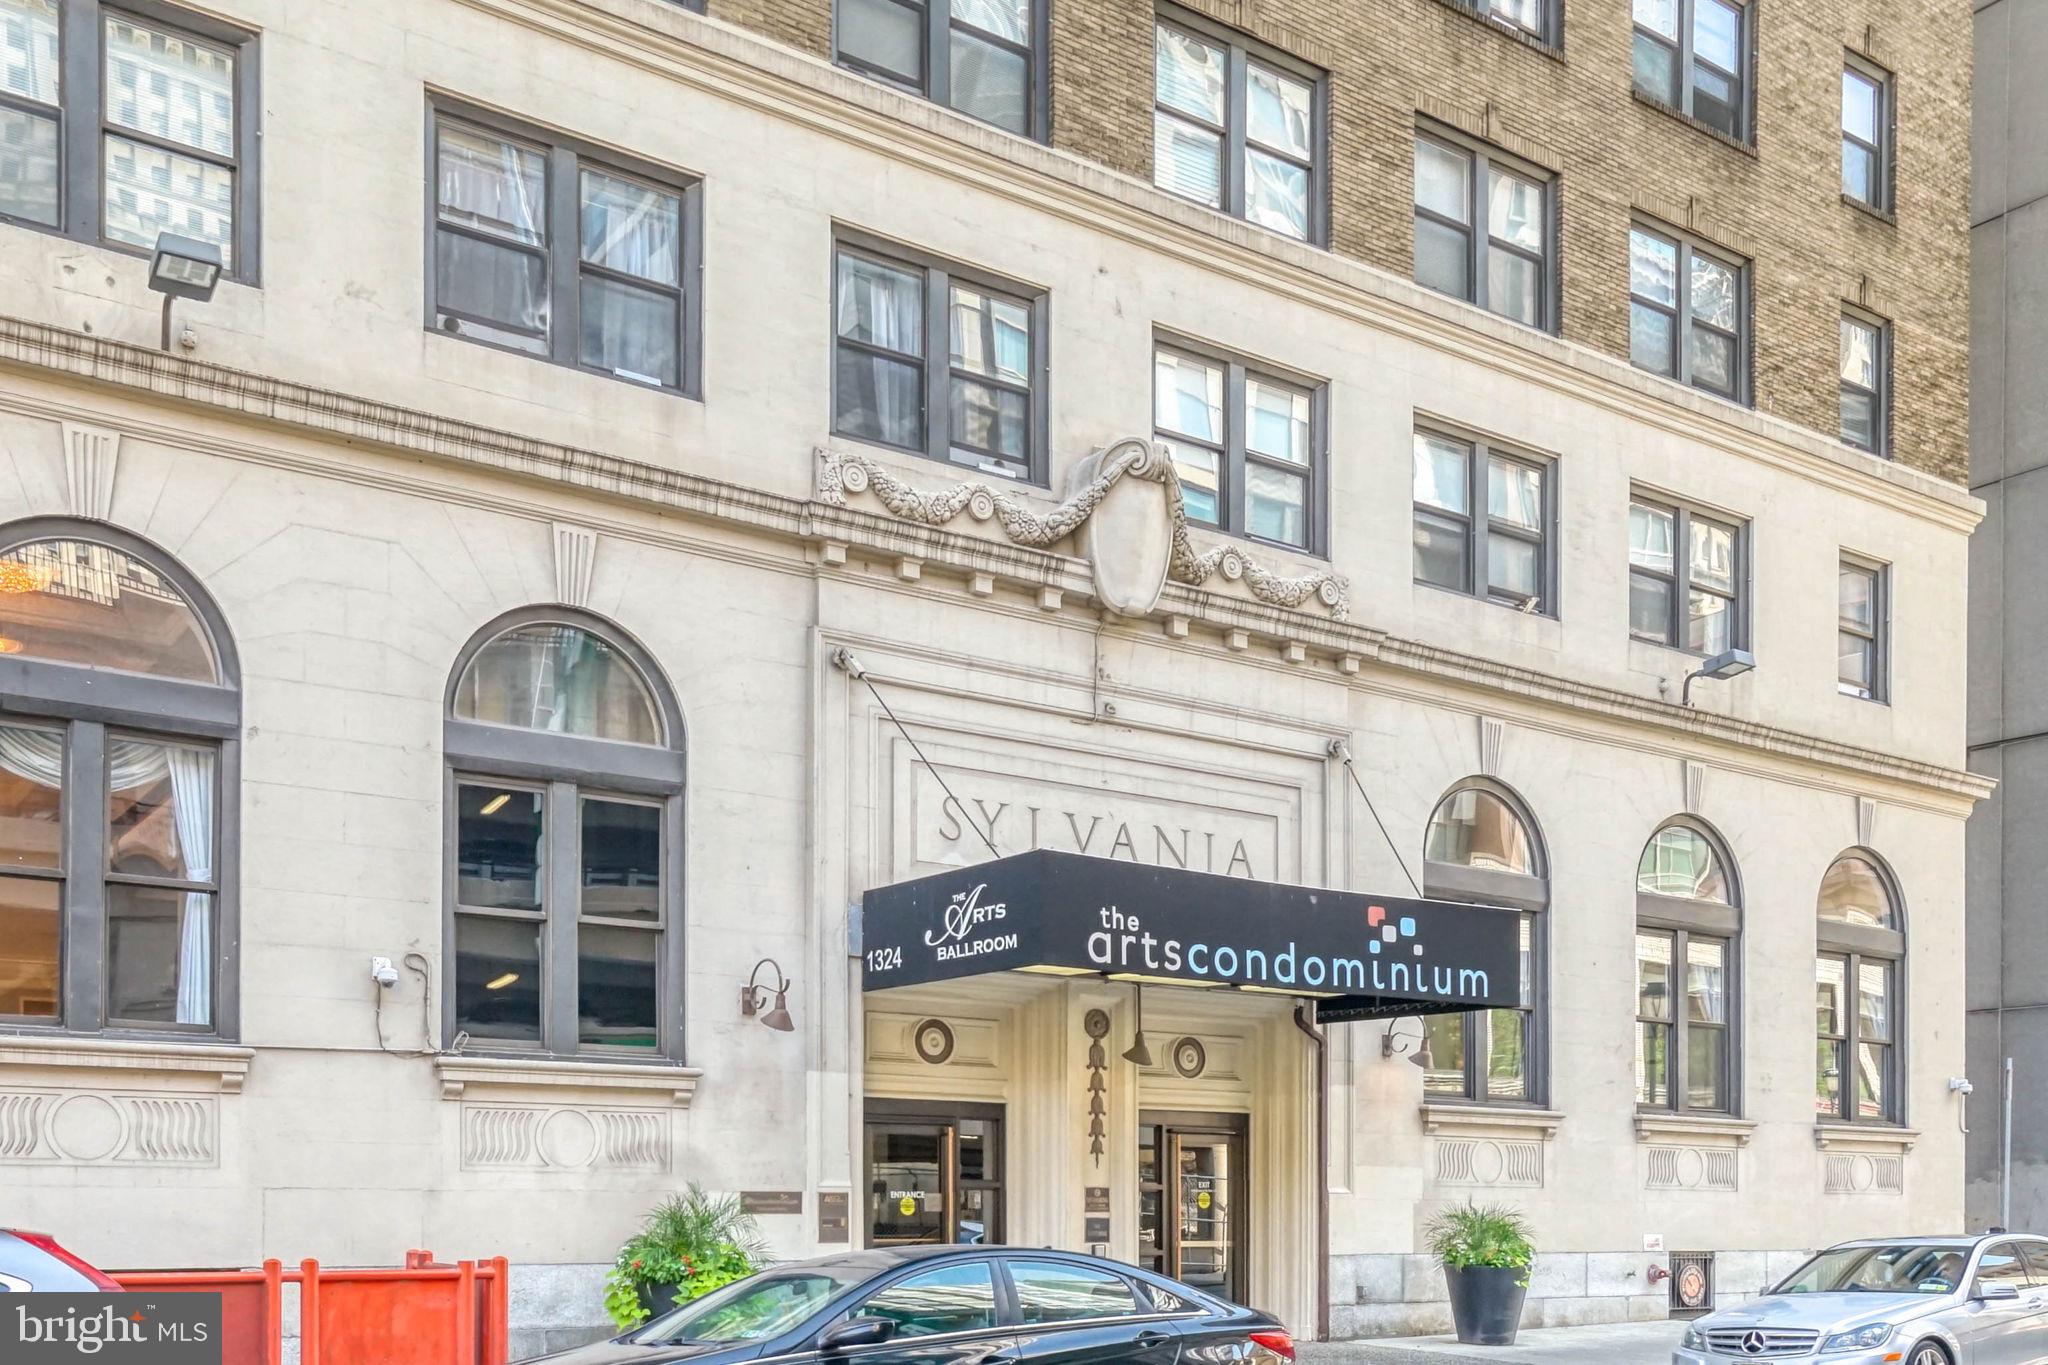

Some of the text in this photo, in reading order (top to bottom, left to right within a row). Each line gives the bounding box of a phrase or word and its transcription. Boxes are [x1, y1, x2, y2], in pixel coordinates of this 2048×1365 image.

[952, 891, 967, 903] THE
[924, 883, 1007, 946] ARTS
[1100, 905, 1140, 932] the
[866, 946, 903, 972] 1324
[937, 933, 1018, 961] BALLROOM
[890, 1190, 926, 1199] ENTRANCE
[1198, 1181, 1210, 1189] EXIT
